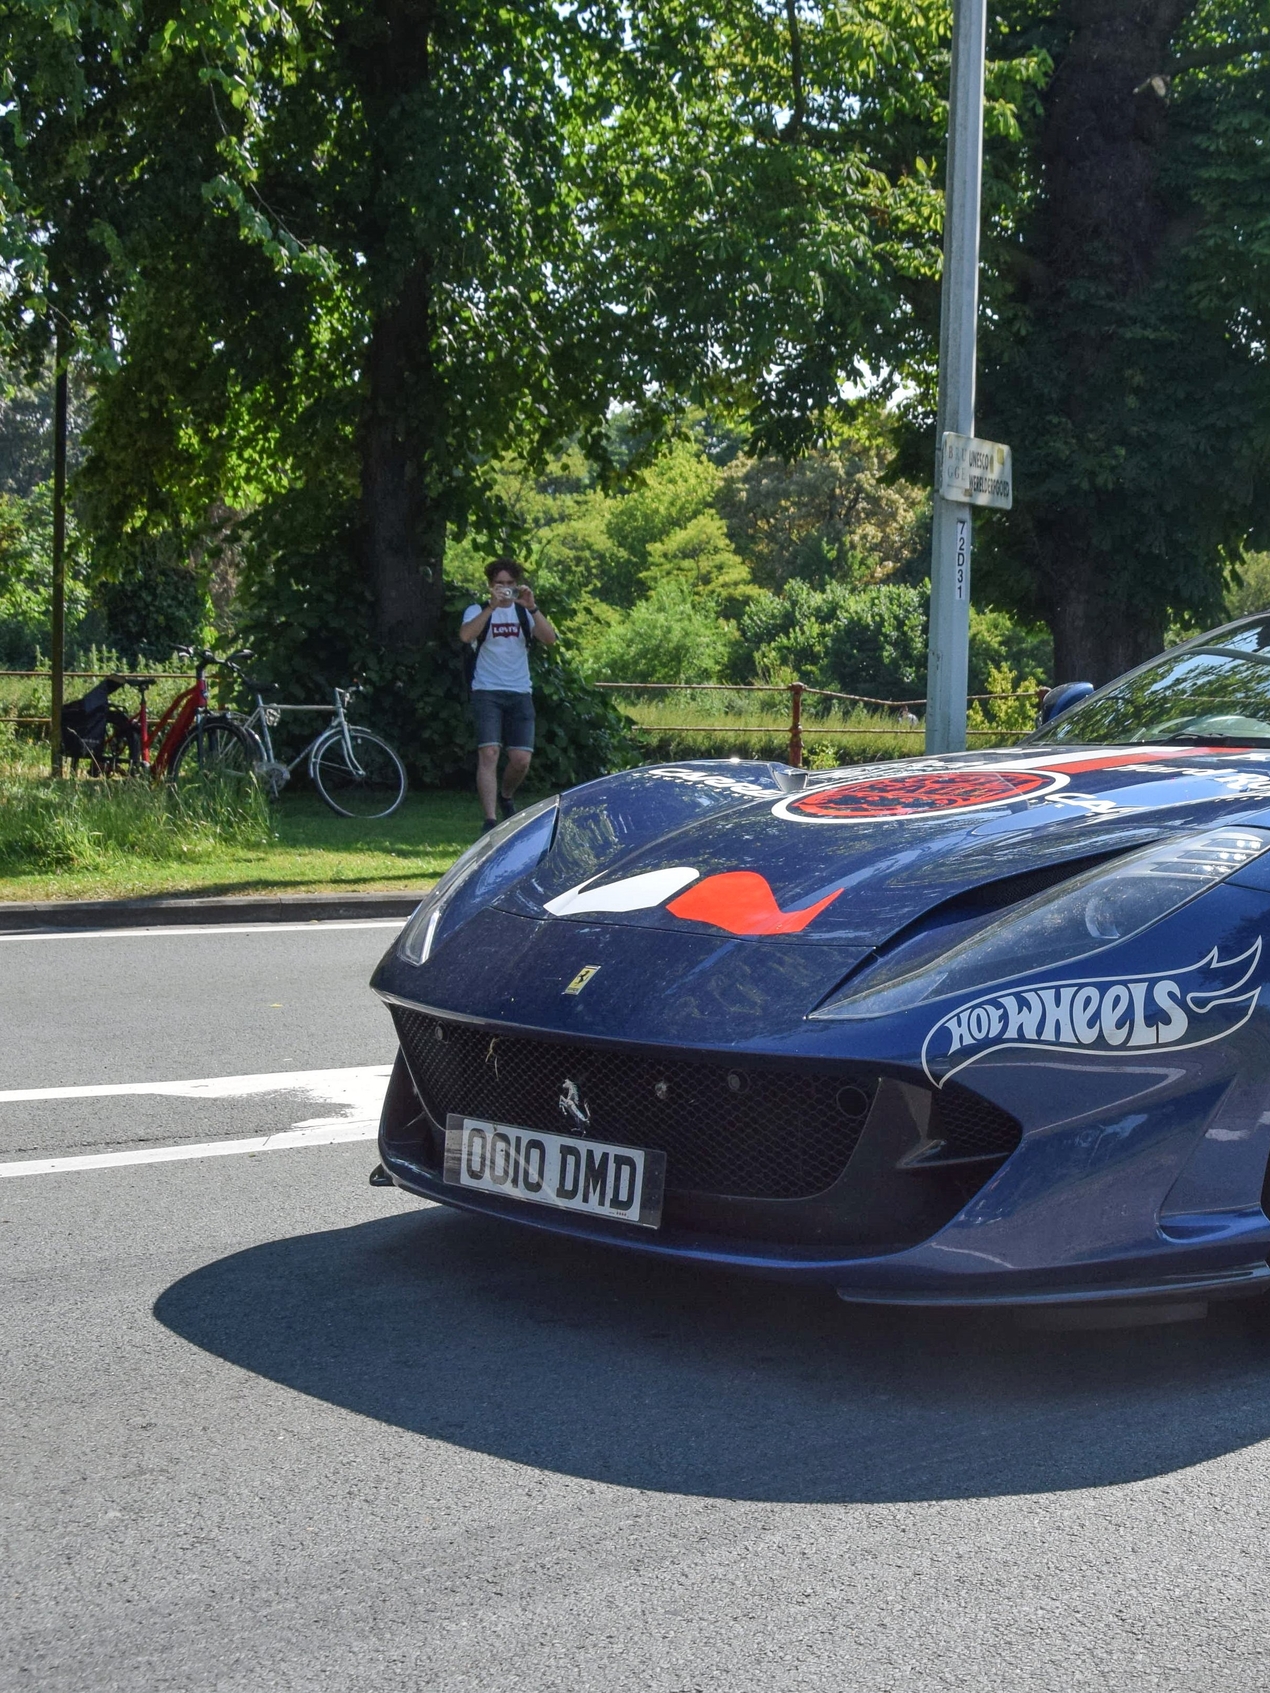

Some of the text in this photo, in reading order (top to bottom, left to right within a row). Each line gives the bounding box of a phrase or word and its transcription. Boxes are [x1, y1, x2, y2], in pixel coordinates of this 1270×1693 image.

[969, 450, 989, 471] UNESCO
[957, 521, 967, 599] 72D31
[556, 1143, 637, 1211] DMD
